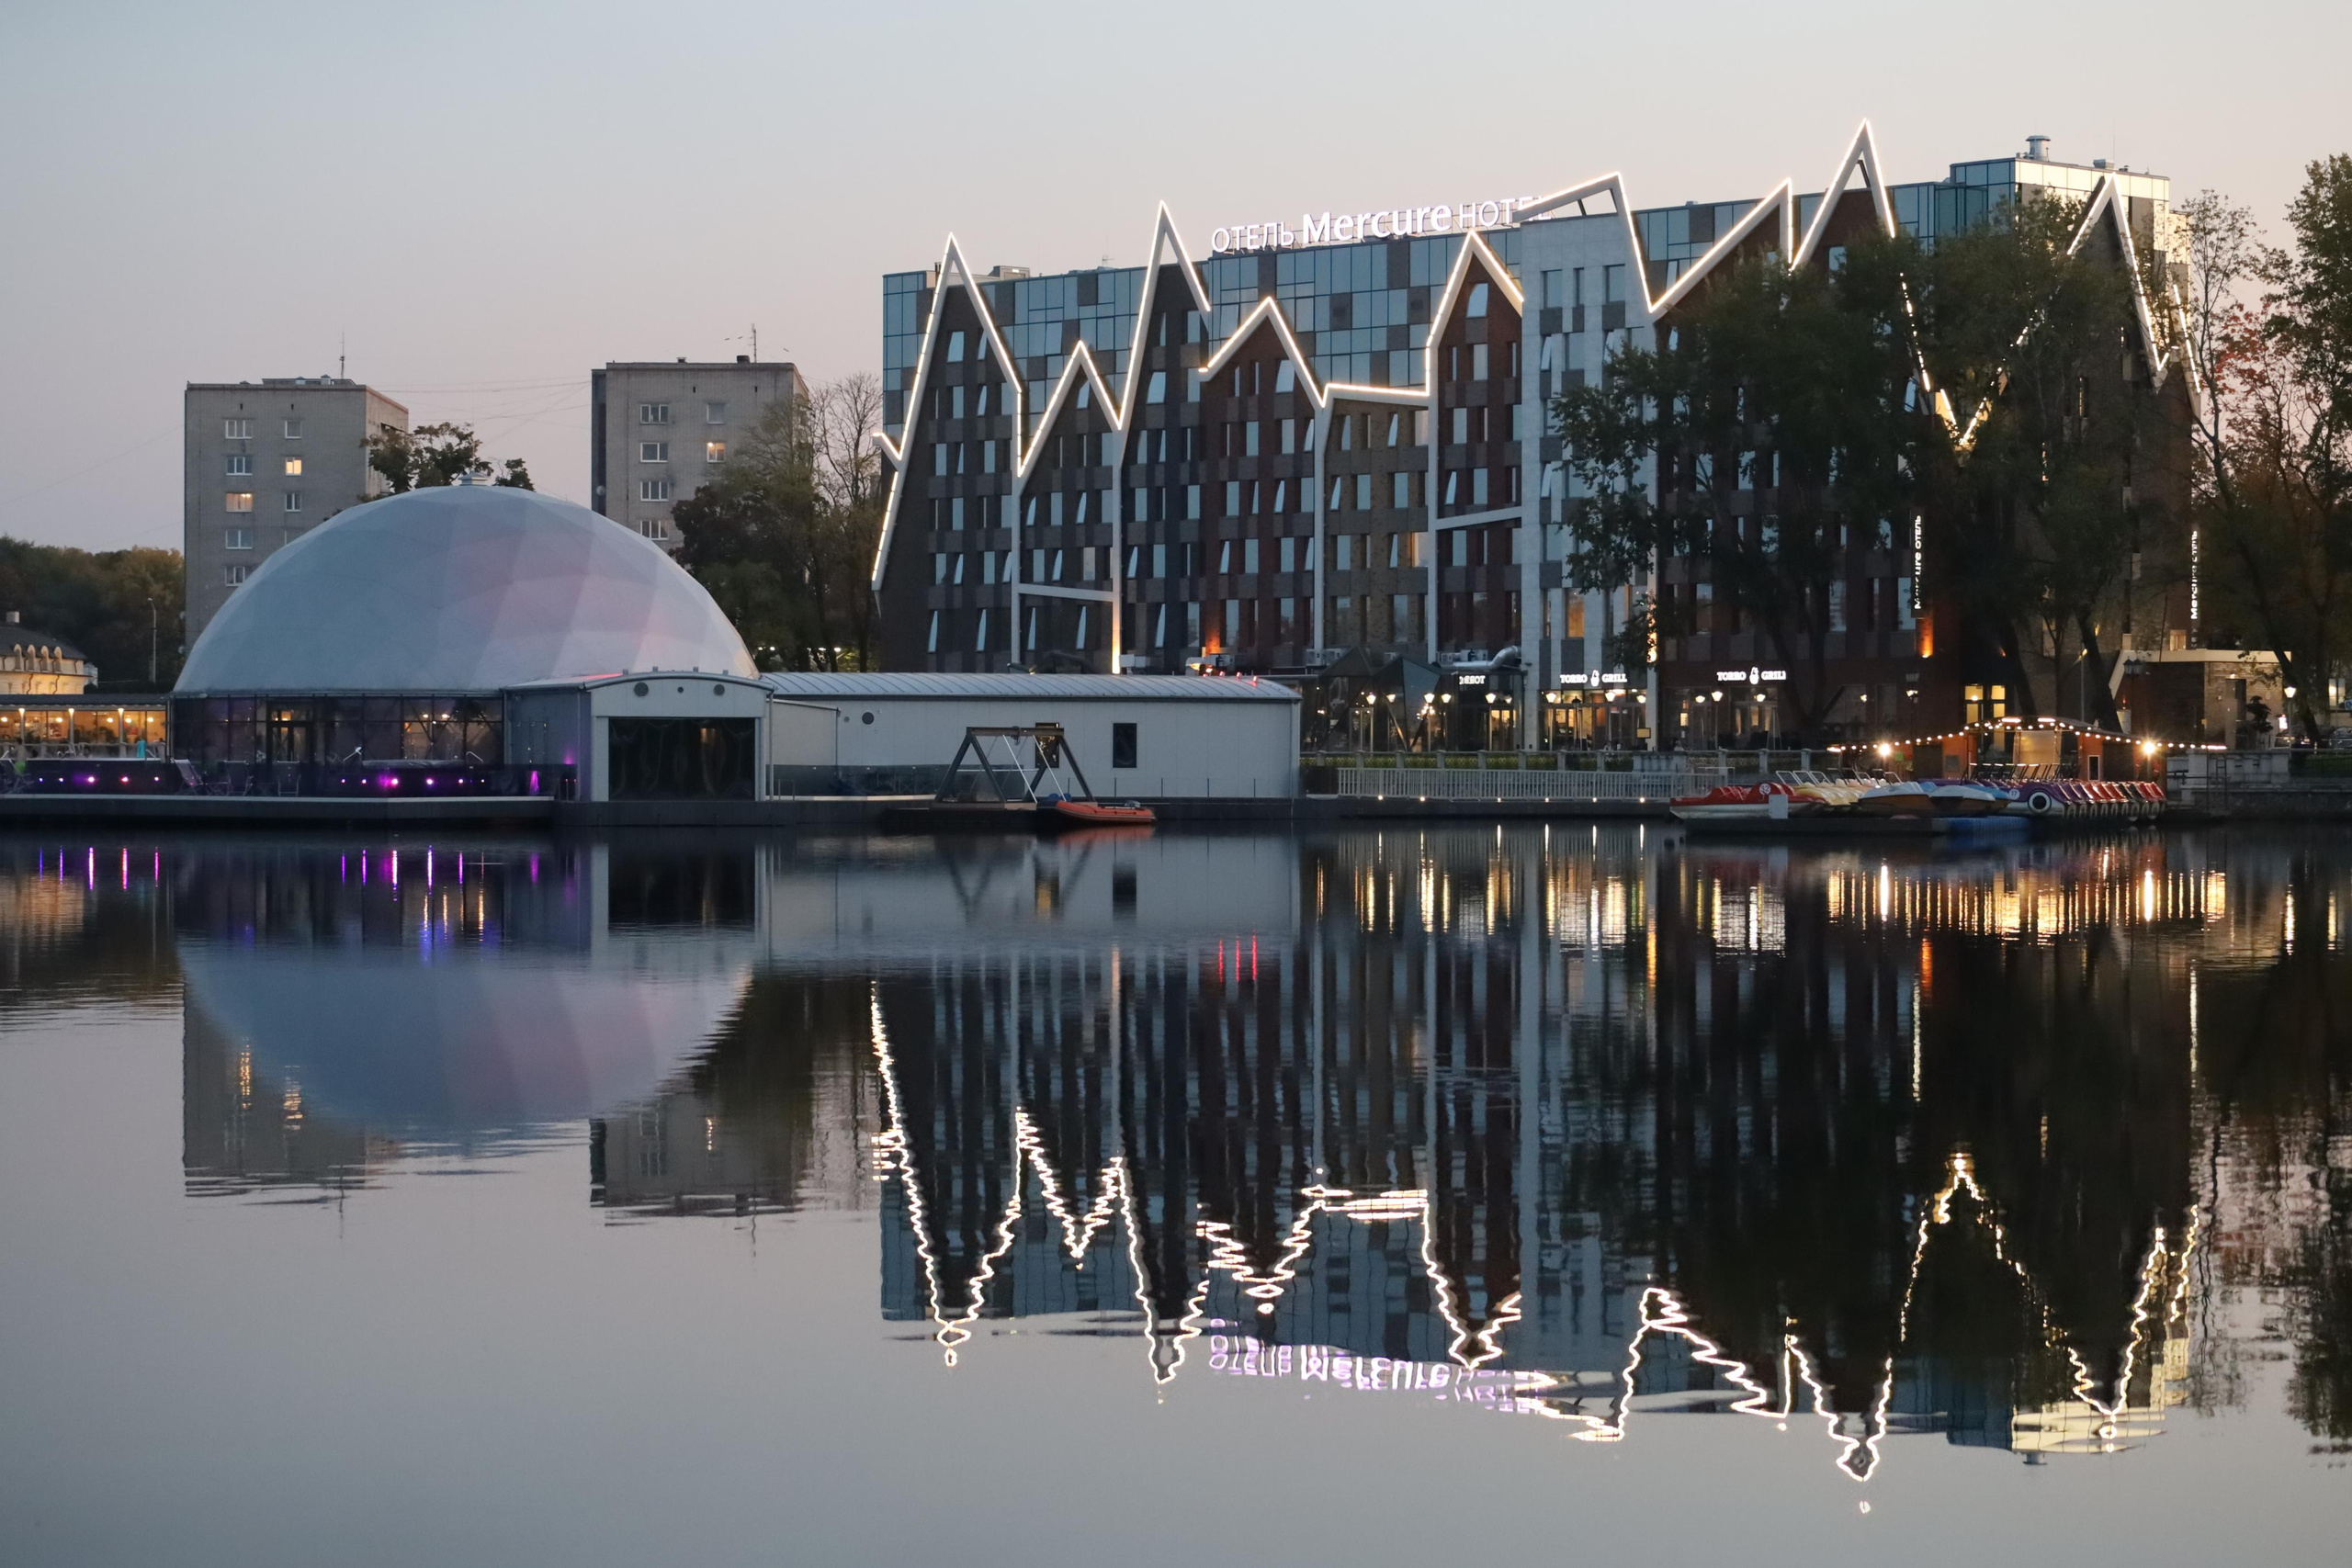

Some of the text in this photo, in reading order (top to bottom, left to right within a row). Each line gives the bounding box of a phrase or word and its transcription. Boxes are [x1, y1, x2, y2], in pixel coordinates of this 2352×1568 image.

[1211, 221, 1295, 253] ОТЕЛЬ
[1302, 204, 1453, 244] Mercure
[1601, 673, 1628, 682] GRILL
